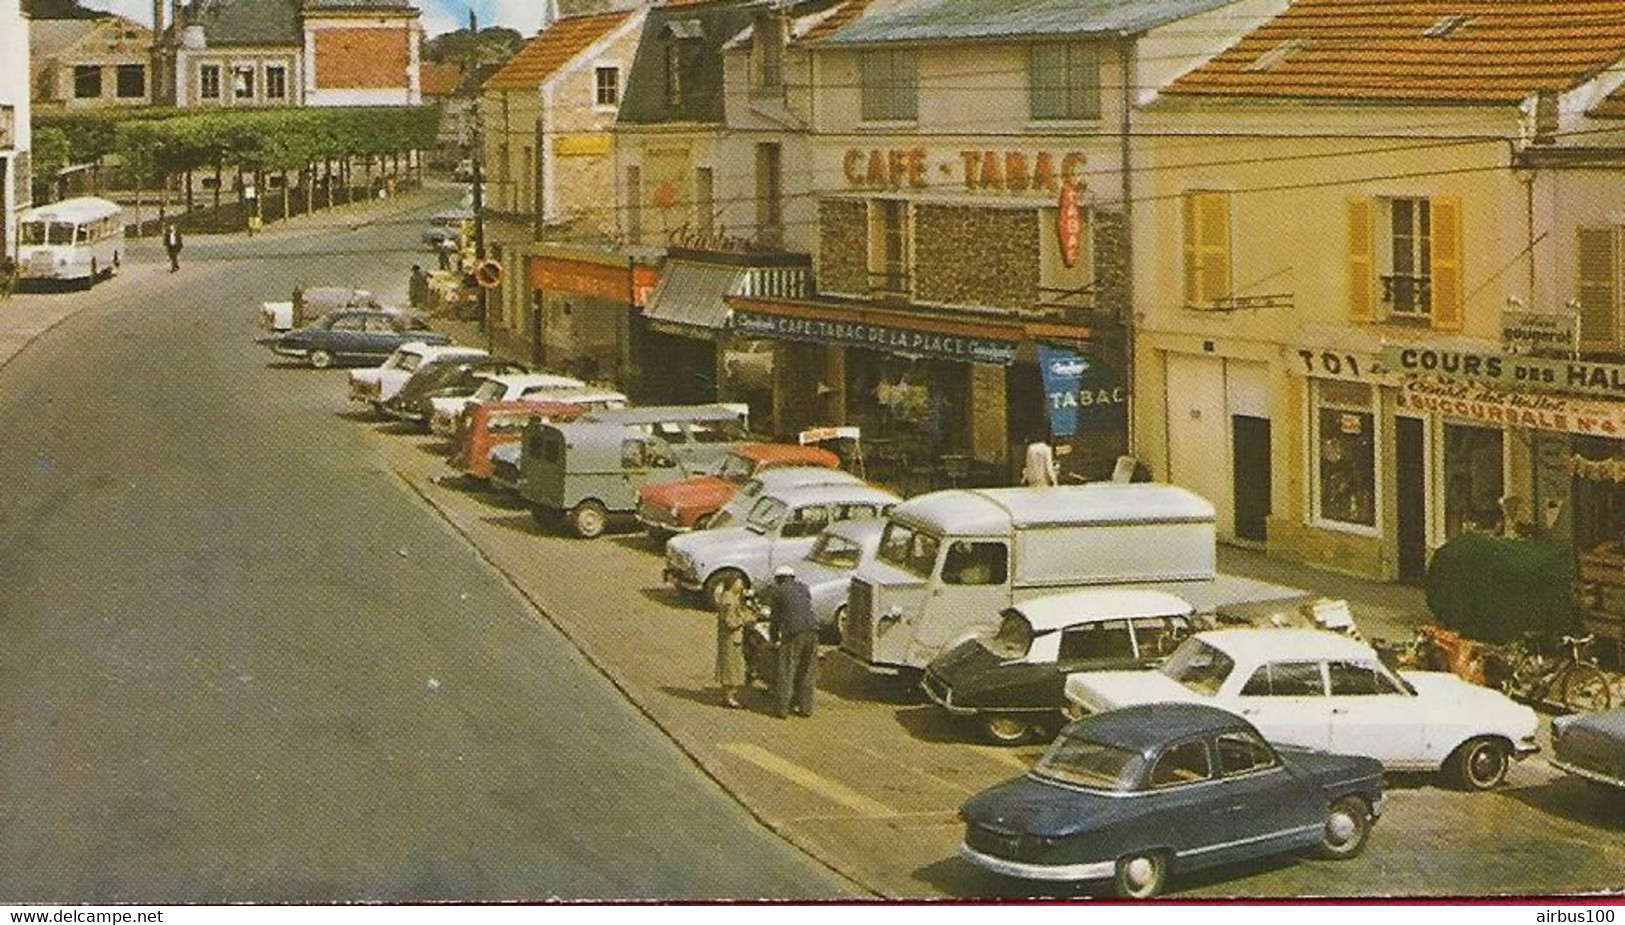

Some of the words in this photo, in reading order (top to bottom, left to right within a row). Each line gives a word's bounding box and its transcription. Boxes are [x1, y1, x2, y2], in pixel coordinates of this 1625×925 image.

[960, 150, 1087, 191] TABAC
[868, 327, 886, 343] DE
[890, 331, 908, 347] LA
[912, 334, 964, 354] PLACE
[1401, 349, 1503, 378] COURS
[1515, 365, 1555, 383] DES
[1567, 364, 1625, 390] HAL
[1050, 387, 1124, 409] TABAC
